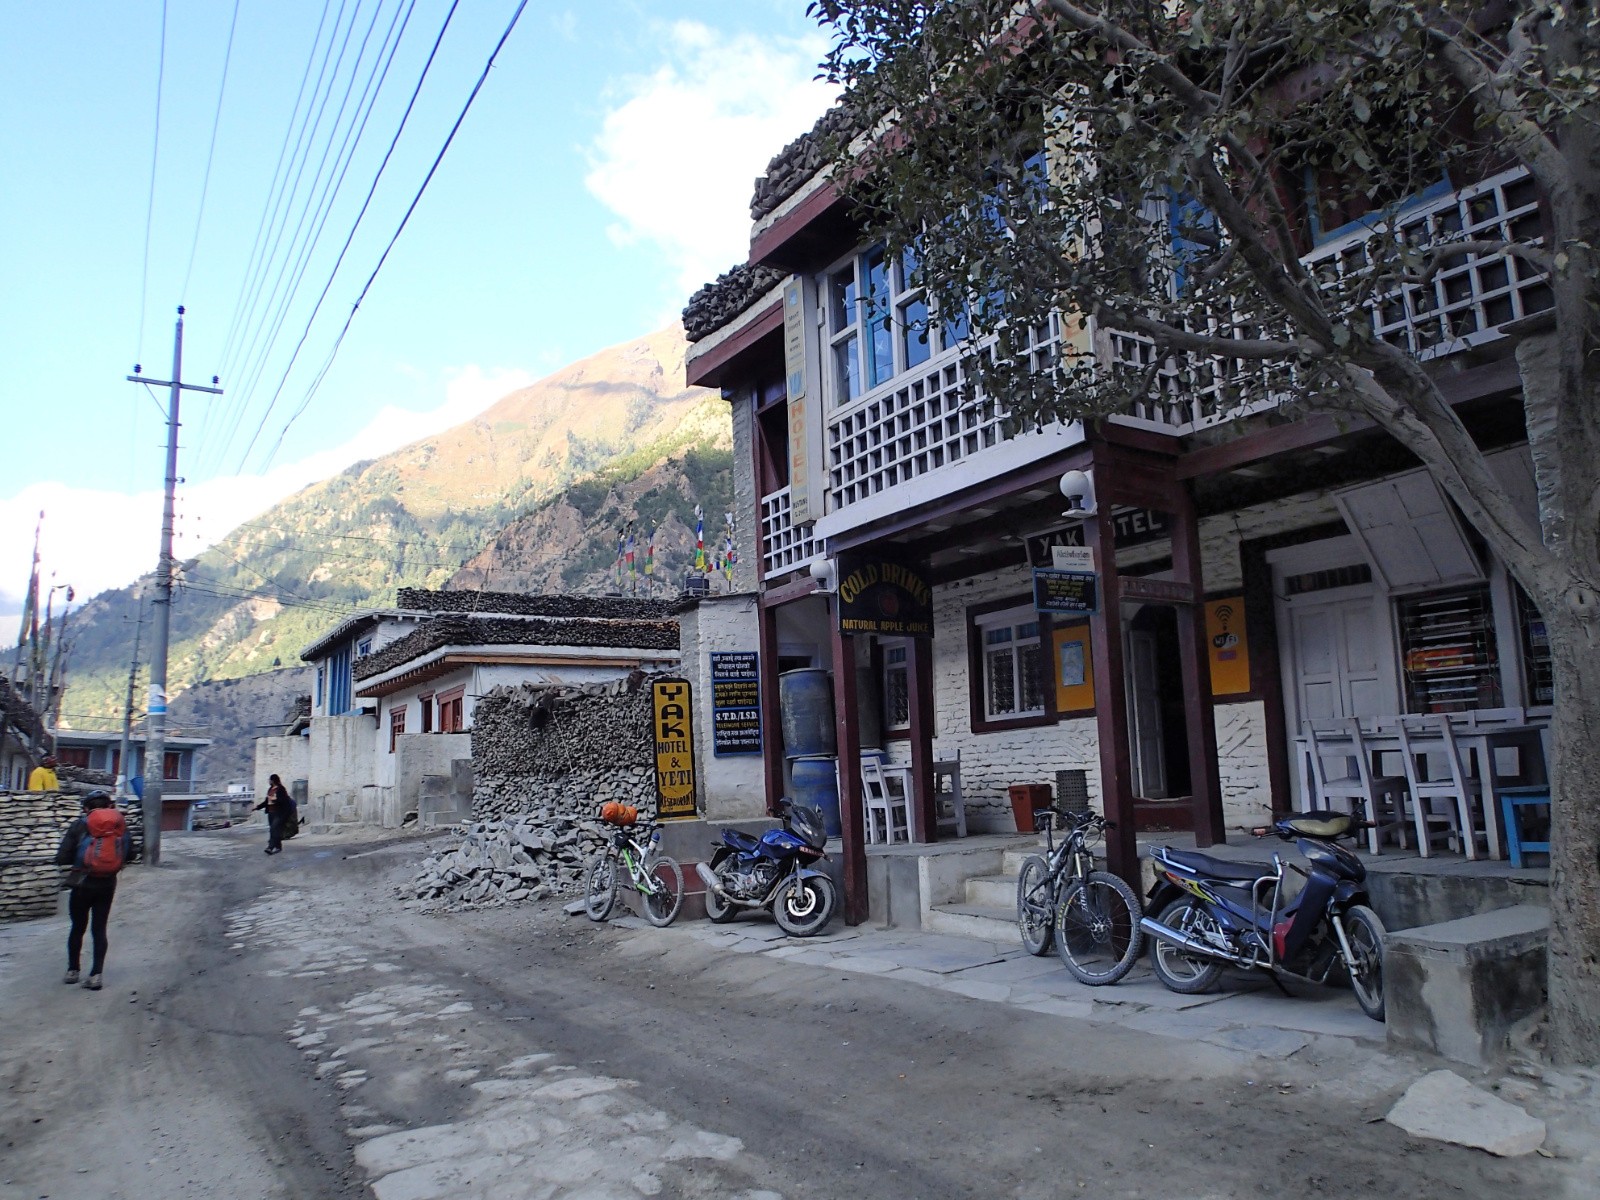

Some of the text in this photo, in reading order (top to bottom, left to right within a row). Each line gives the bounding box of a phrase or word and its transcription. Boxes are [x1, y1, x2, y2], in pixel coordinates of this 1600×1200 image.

[790, 402, 804, 484] HOTEL
[840, 562, 929, 607] COLD DRINKS
[842, 619, 929, 632] NATURAL APPLE JUICE
[660, 685, 685, 739] YAK
[657, 740, 688, 754] HOTEL
[670, 756, 681, 768] &
[659, 769, 692, 787] YETI
